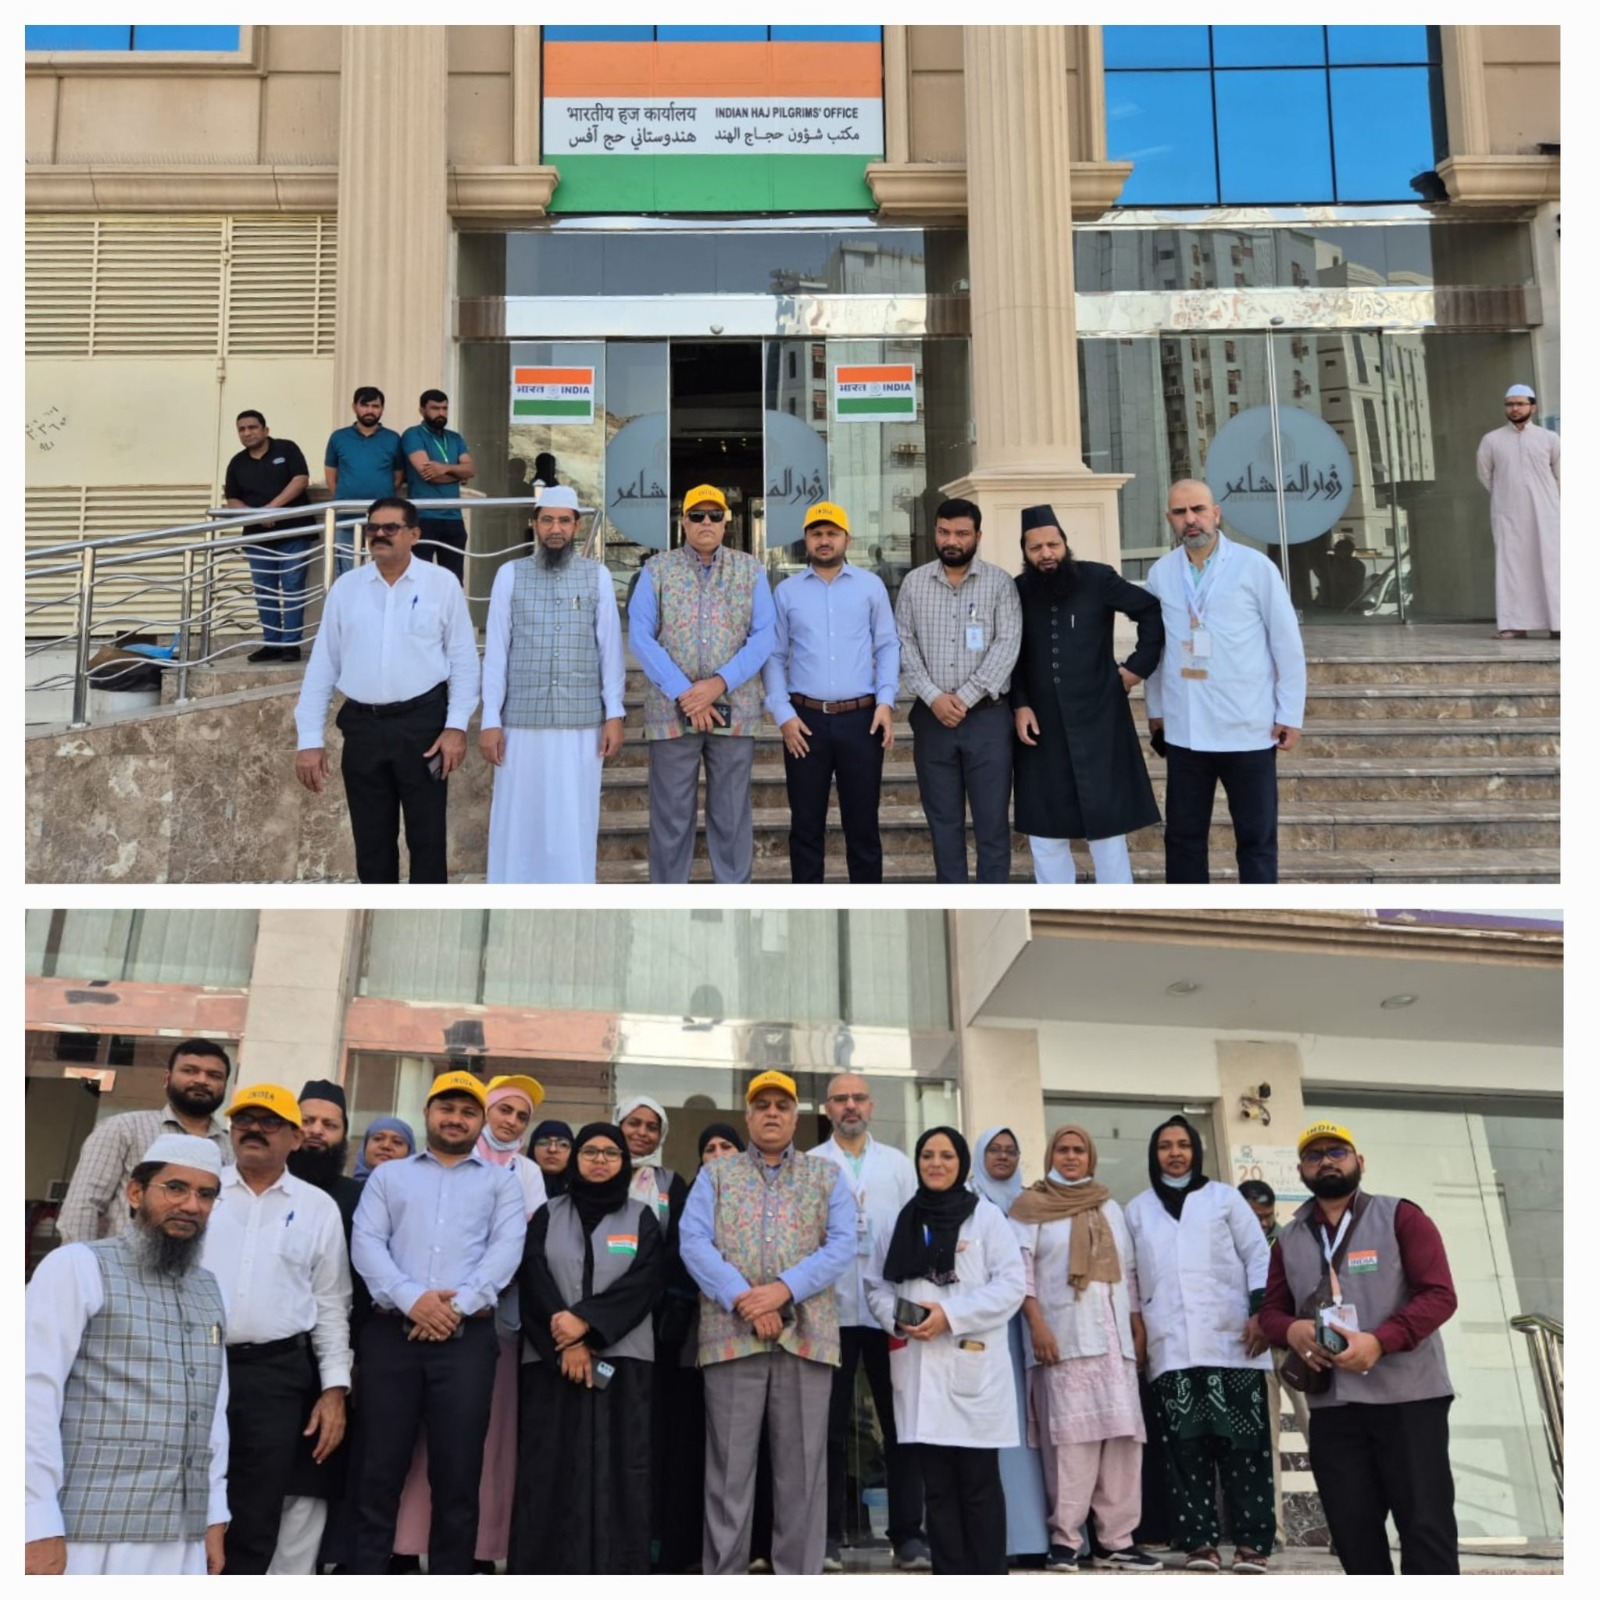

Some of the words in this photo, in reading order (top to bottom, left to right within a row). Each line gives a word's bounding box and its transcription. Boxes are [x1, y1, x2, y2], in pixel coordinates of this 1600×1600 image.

[567, 103, 614, 121] भारतीय
[618, 107, 641, 125] हज
[643, 101, 697, 121] कार्यालय
[715, 107, 748, 118] INDIAN
[751, 107, 770, 118] HAJ
[823, 107, 858, 118] OFFICE
[569, 124, 599, 148] آفس
[715, 127, 741, 143] الهند
[827, 126, 860, 145] مكتب
[603, 133, 625, 151] حج
[517, 386, 544, 394] भारत
[561, 386, 590, 394] INDIA
[839, 383, 867, 392] भारत
[883, 383, 911, 392] INDIA
[450, 1077, 473, 1087] INDIA
[247, 1089, 275, 1101] INDIA
[1306, 1124, 1338, 1136] INDIA
